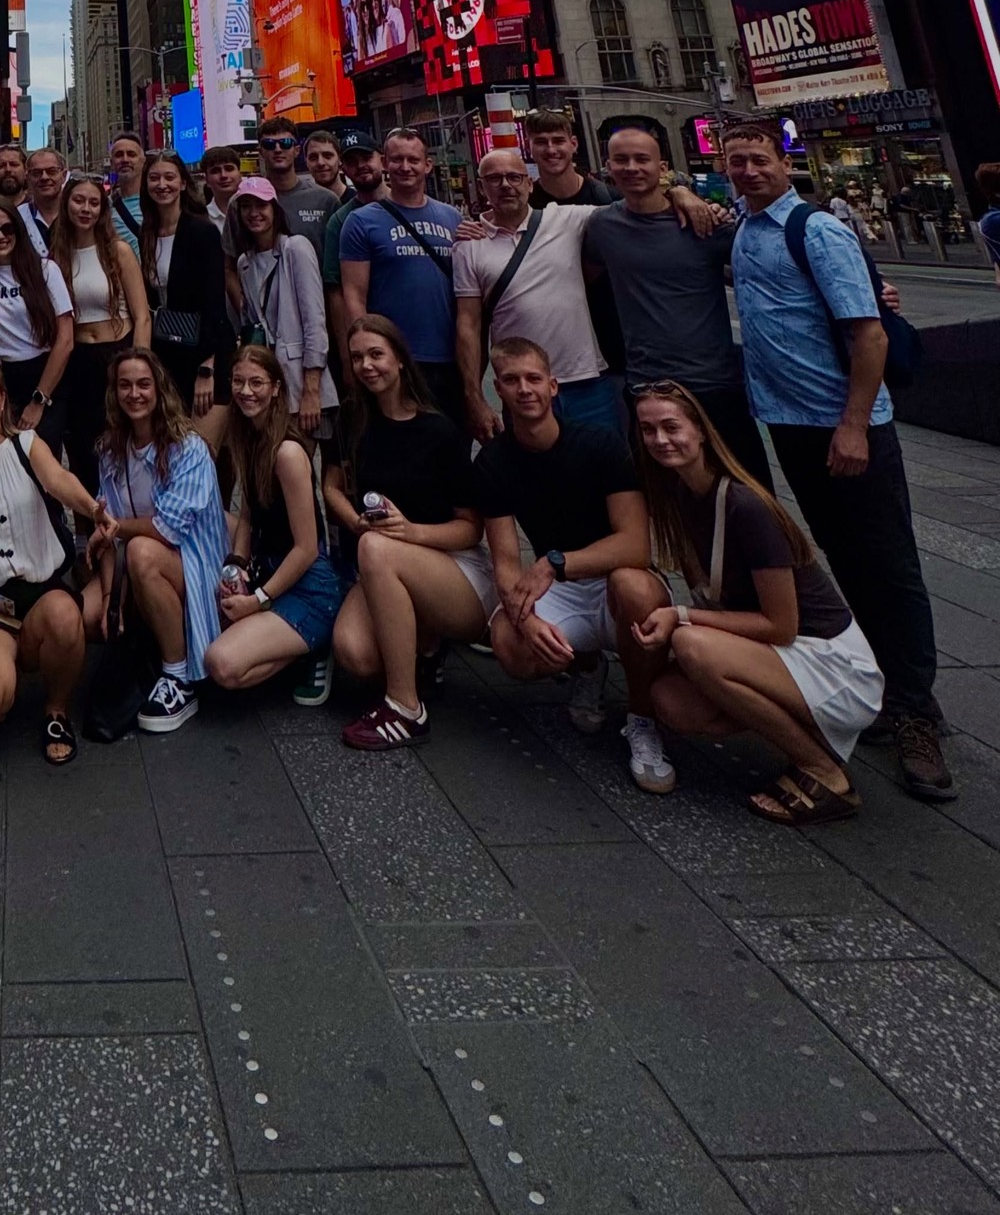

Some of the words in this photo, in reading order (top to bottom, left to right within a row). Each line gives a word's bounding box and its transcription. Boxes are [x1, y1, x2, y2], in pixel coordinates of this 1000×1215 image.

[751, 49, 798, 68] BROADWAY'S
[798, 44, 828, 60] GLOBAL
[793, 100, 839, 120] GIFTS
[847, 88, 931, 115] LUGGAGE
[875, 122, 904, 133] SONY
[298, 209, 326, 217] GALLERY
